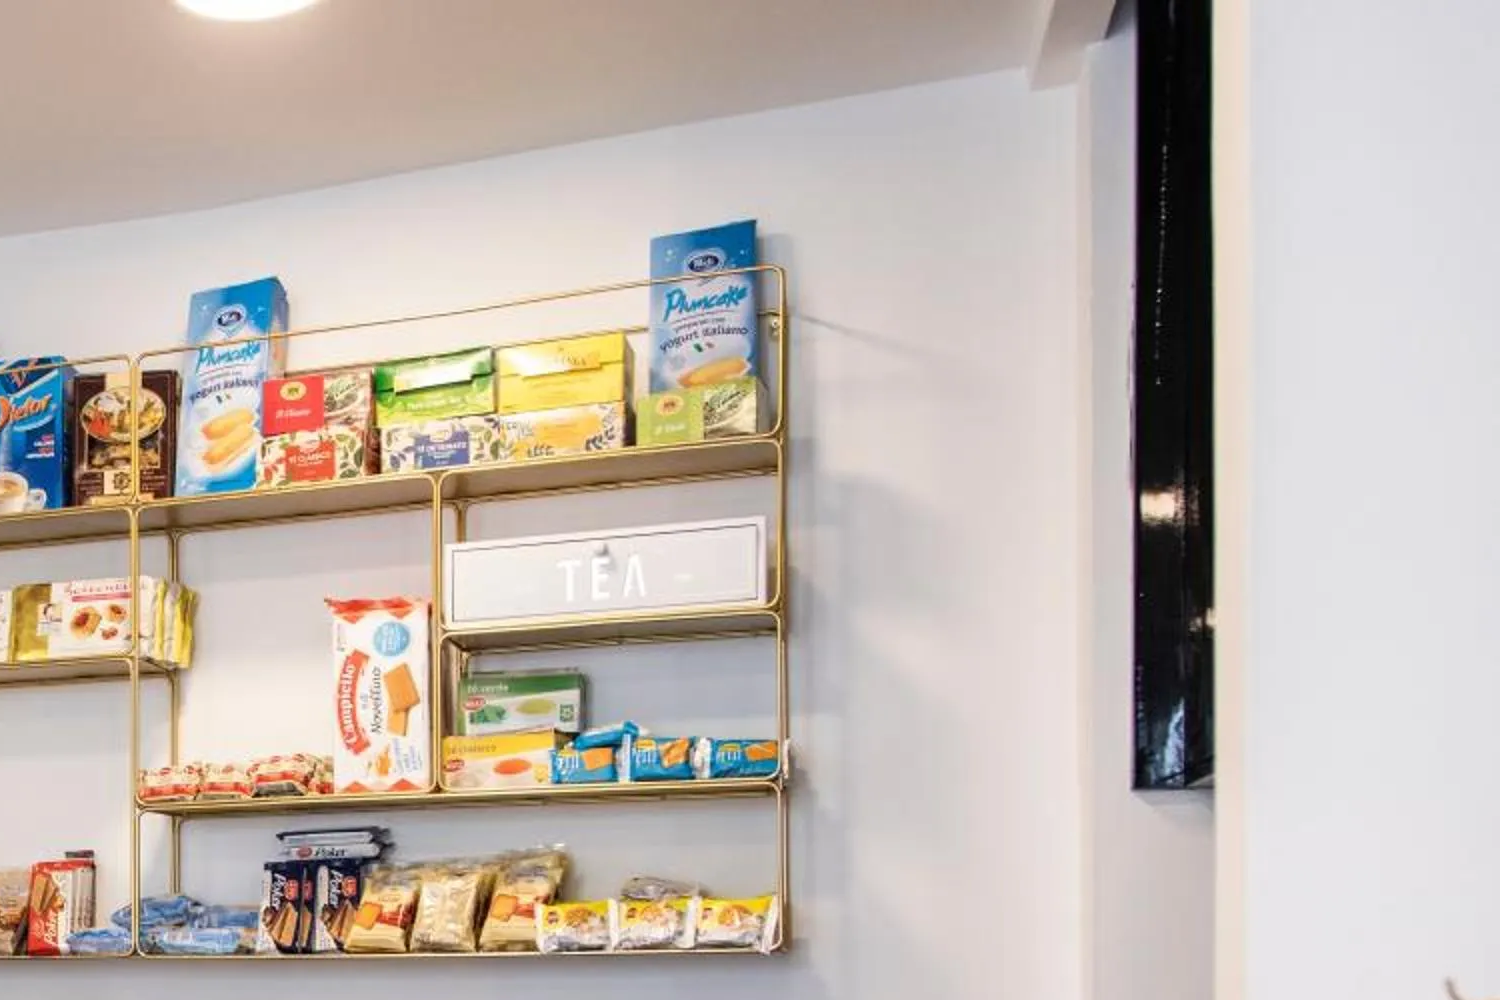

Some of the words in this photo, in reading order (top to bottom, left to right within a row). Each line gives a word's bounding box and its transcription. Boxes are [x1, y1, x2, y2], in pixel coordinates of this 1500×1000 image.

[663, 285, 748, 322] Plumcake
[659, 330, 699, 355] yogurt
[703, 325, 750, 338] italiano
[556, 553, 647, 603] TEA
[272, 873, 287, 910] Poker
[330, 869, 344, 908] Poker
